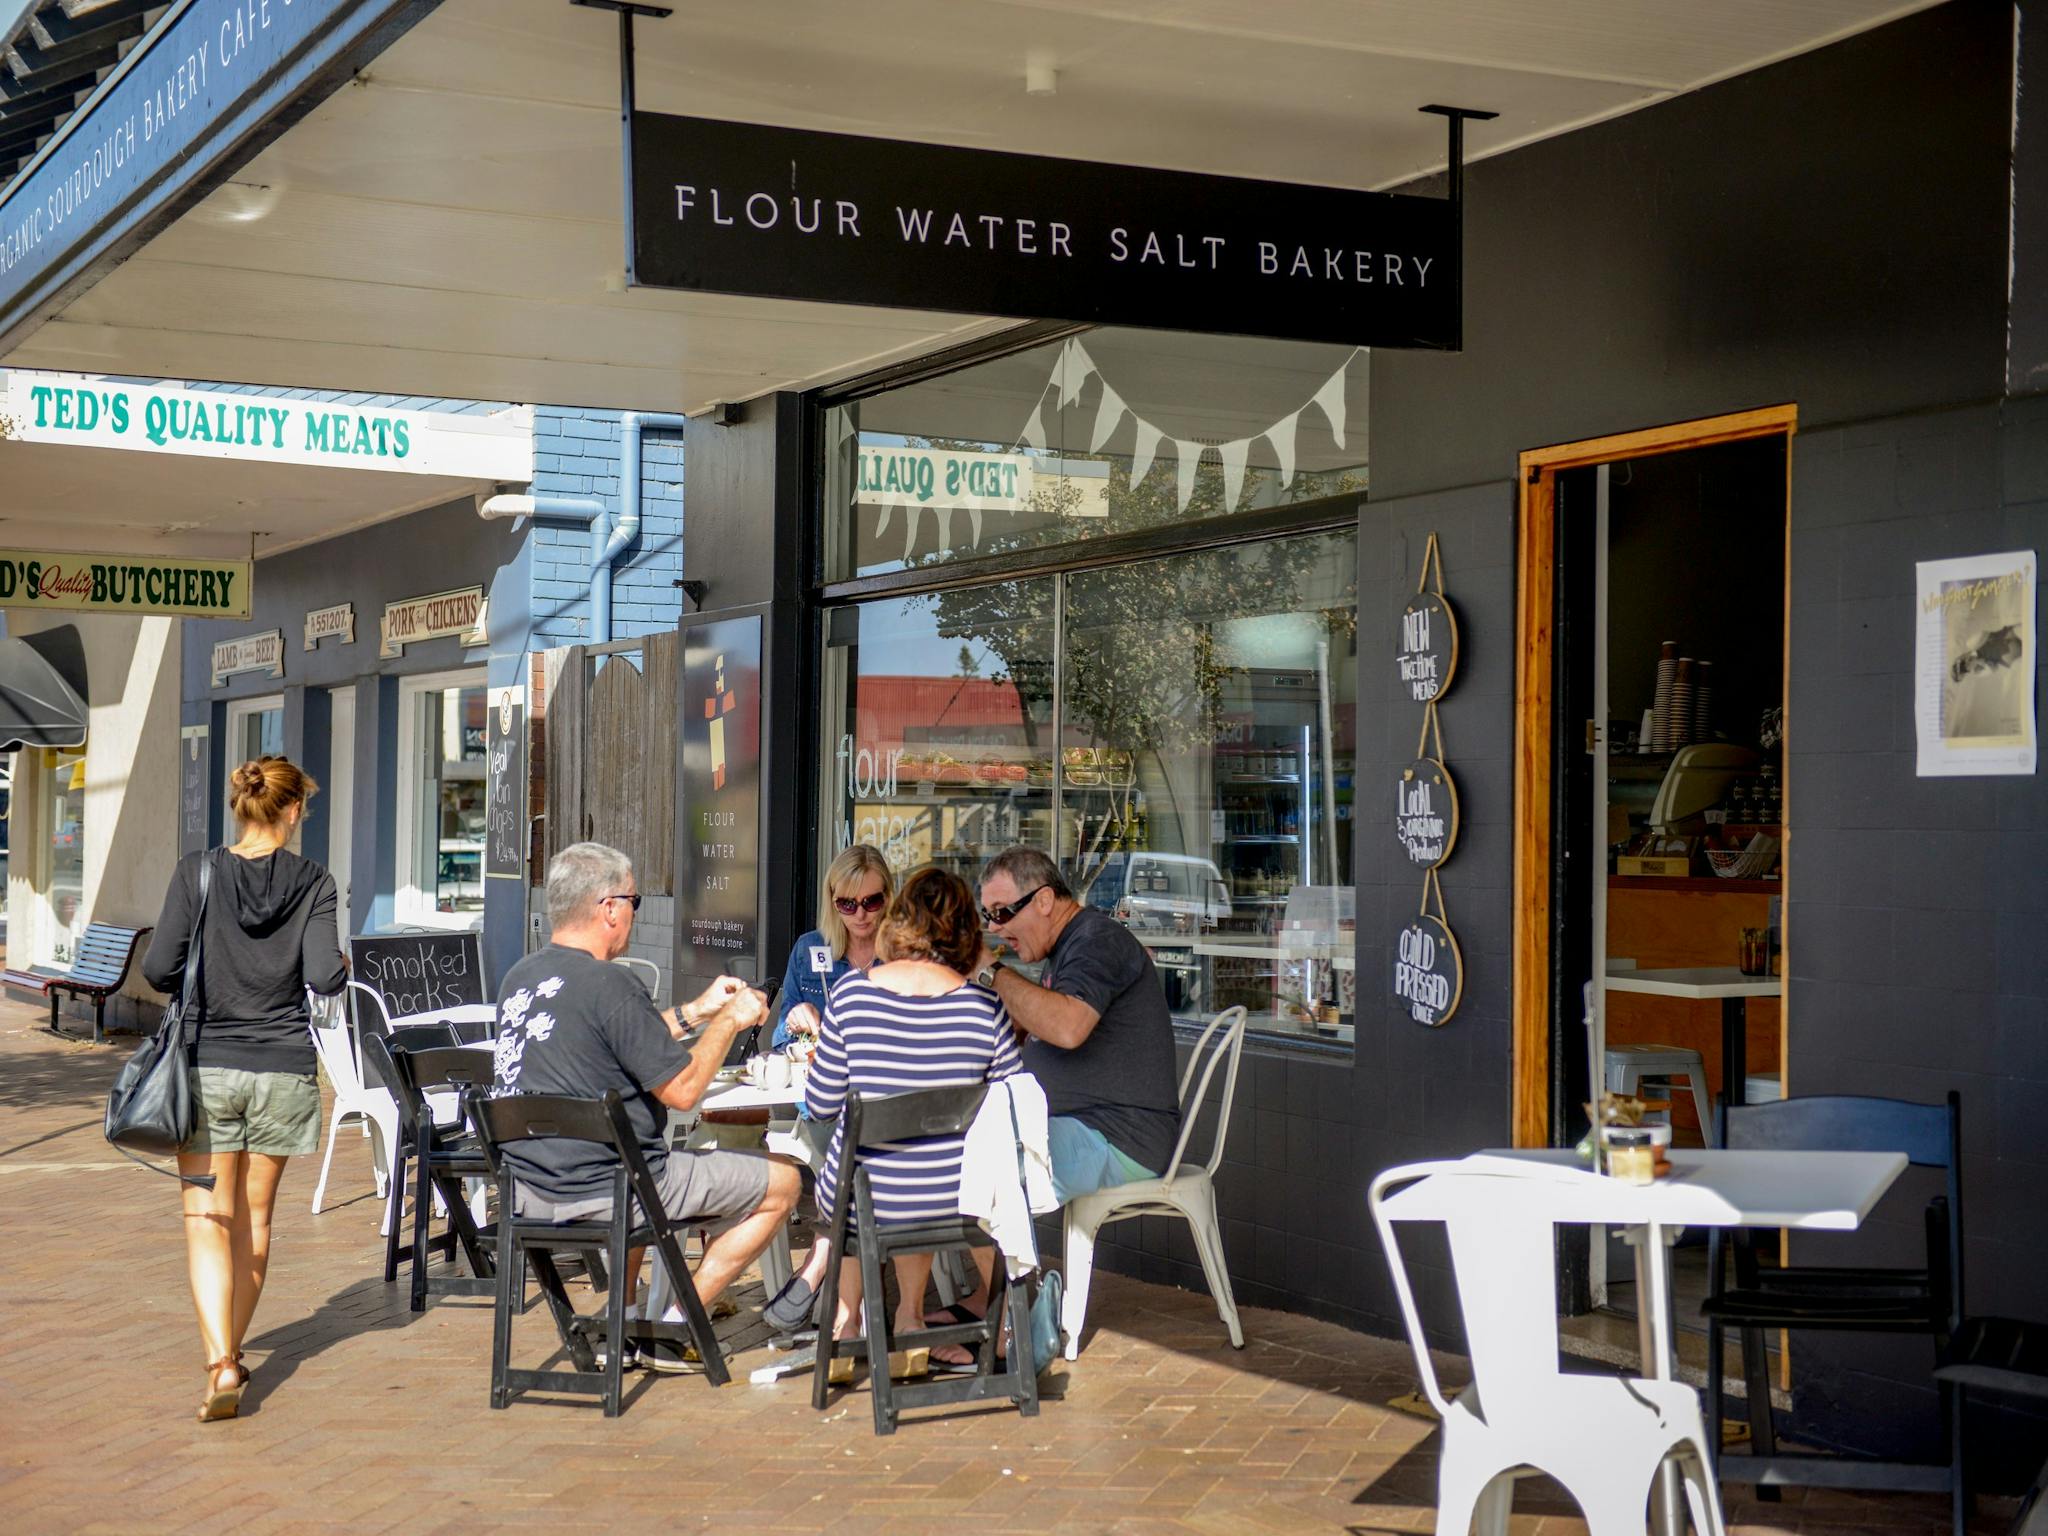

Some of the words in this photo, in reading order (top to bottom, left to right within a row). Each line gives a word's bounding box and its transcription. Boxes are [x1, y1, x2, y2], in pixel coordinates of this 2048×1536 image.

[48, 115, 135, 231] SOURDOUGH
[144, 41, 208, 141] BAKERY
[675, 184, 861, 237] FLOUR
[896, 206, 1074, 258] WATER
[1110, 227, 1226, 270] SALT
[1260, 241, 1435, 289] BAKERY
[31, 385, 130, 434] TED'S
[144, 395, 290, 447] QUALITY
[304, 411, 410, 458] MEATS
[39, 564, 93, 603] Quality
[91, 564, 235, 608] BUTCHERY
[388, 605, 416, 638] PORK
[426, 594, 477, 631] CHICKENS
[1403, 607, 1430, 653] NEW
[217, 645, 238, 671] LAMB
[255, 636, 276, 664] BEEF
[836, 733, 905, 813] flour
[703, 812, 735, 827] FLOUR
[702, 843, 736, 858] WATER
[706, 876, 730, 890] SALT
[691, 918, 722, 932] sourdough
[723, 920, 744, 934] bakery
[692, 935, 704, 945] cafe
[711, 936, 725, 948] food
[727, 939, 743, 949] store
[817, 952, 826, 963] 6
[1400, 928, 1434, 971] COLD
[1395, 962, 1449, 1011] PRESSED
